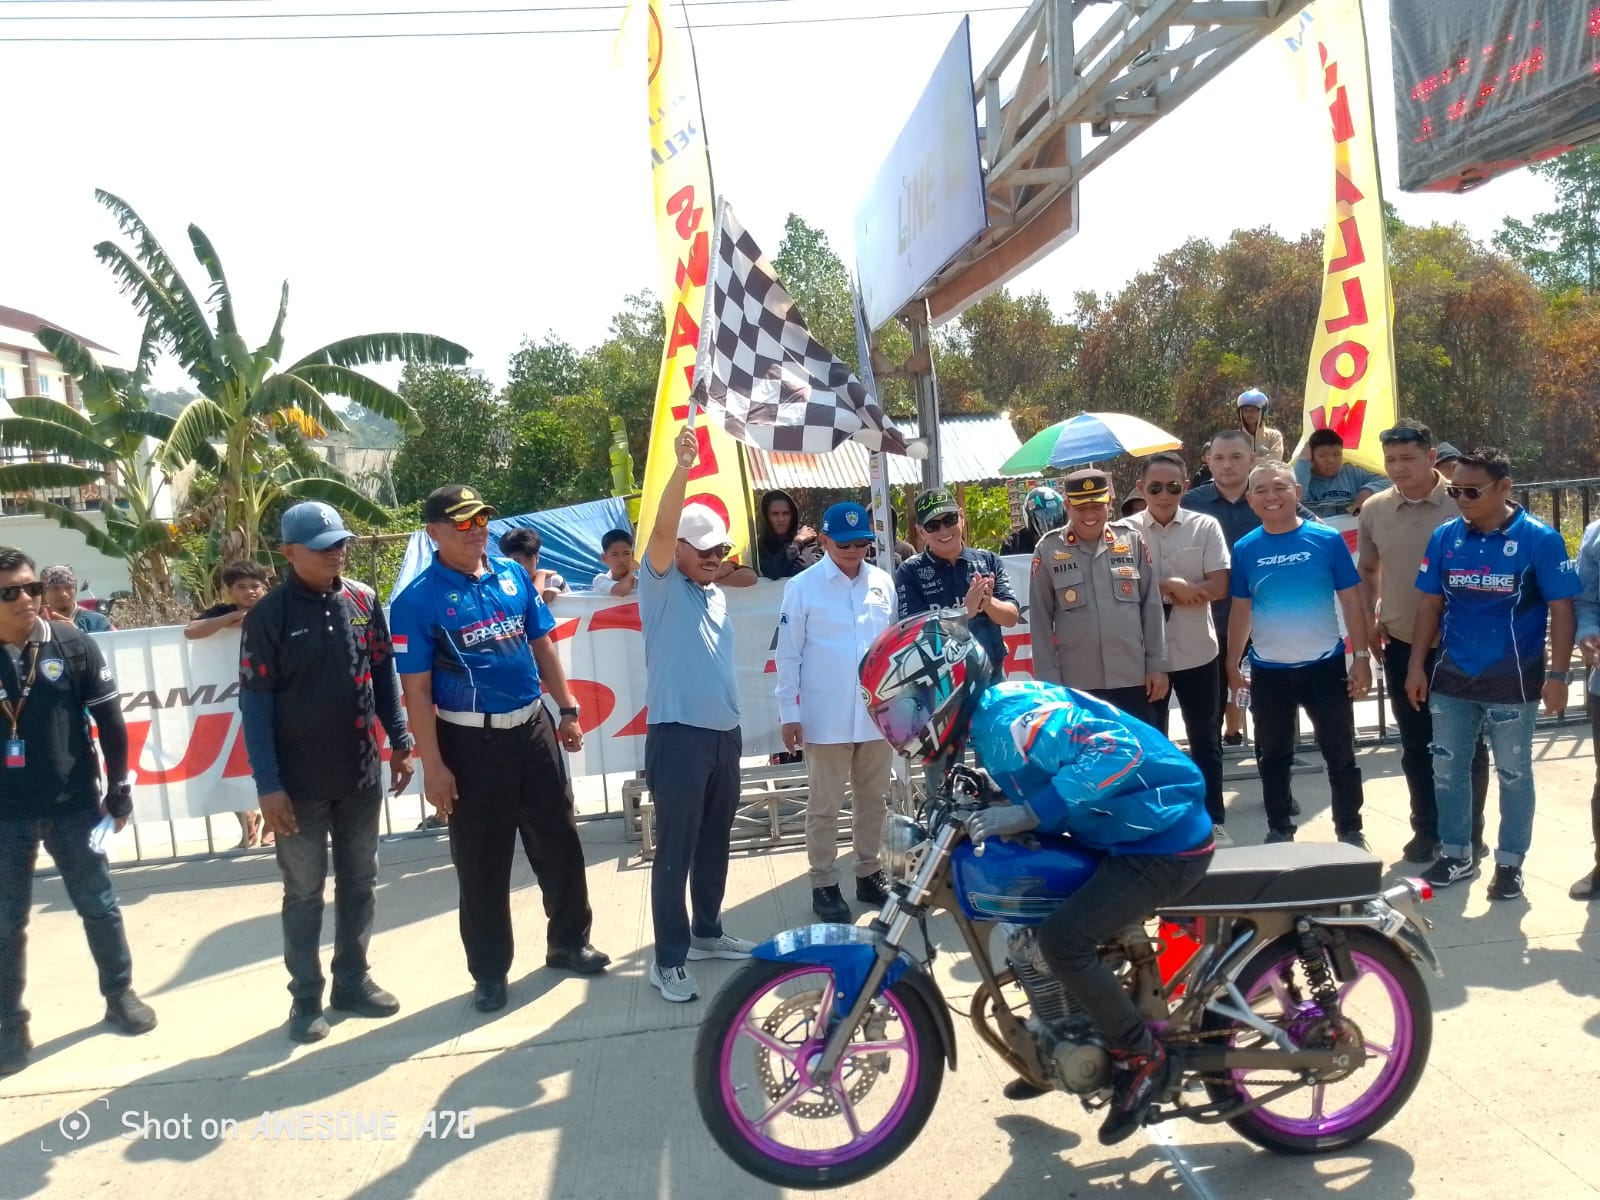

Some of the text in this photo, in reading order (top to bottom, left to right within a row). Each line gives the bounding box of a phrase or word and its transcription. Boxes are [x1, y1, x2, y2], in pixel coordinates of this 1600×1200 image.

[1053, 562, 1079, 573] RIJAL
[1449, 575, 1514, 587] DRAG BIKE
[462, 622, 501, 645] DRAG
[501, 617, 525, 634] BIKE
